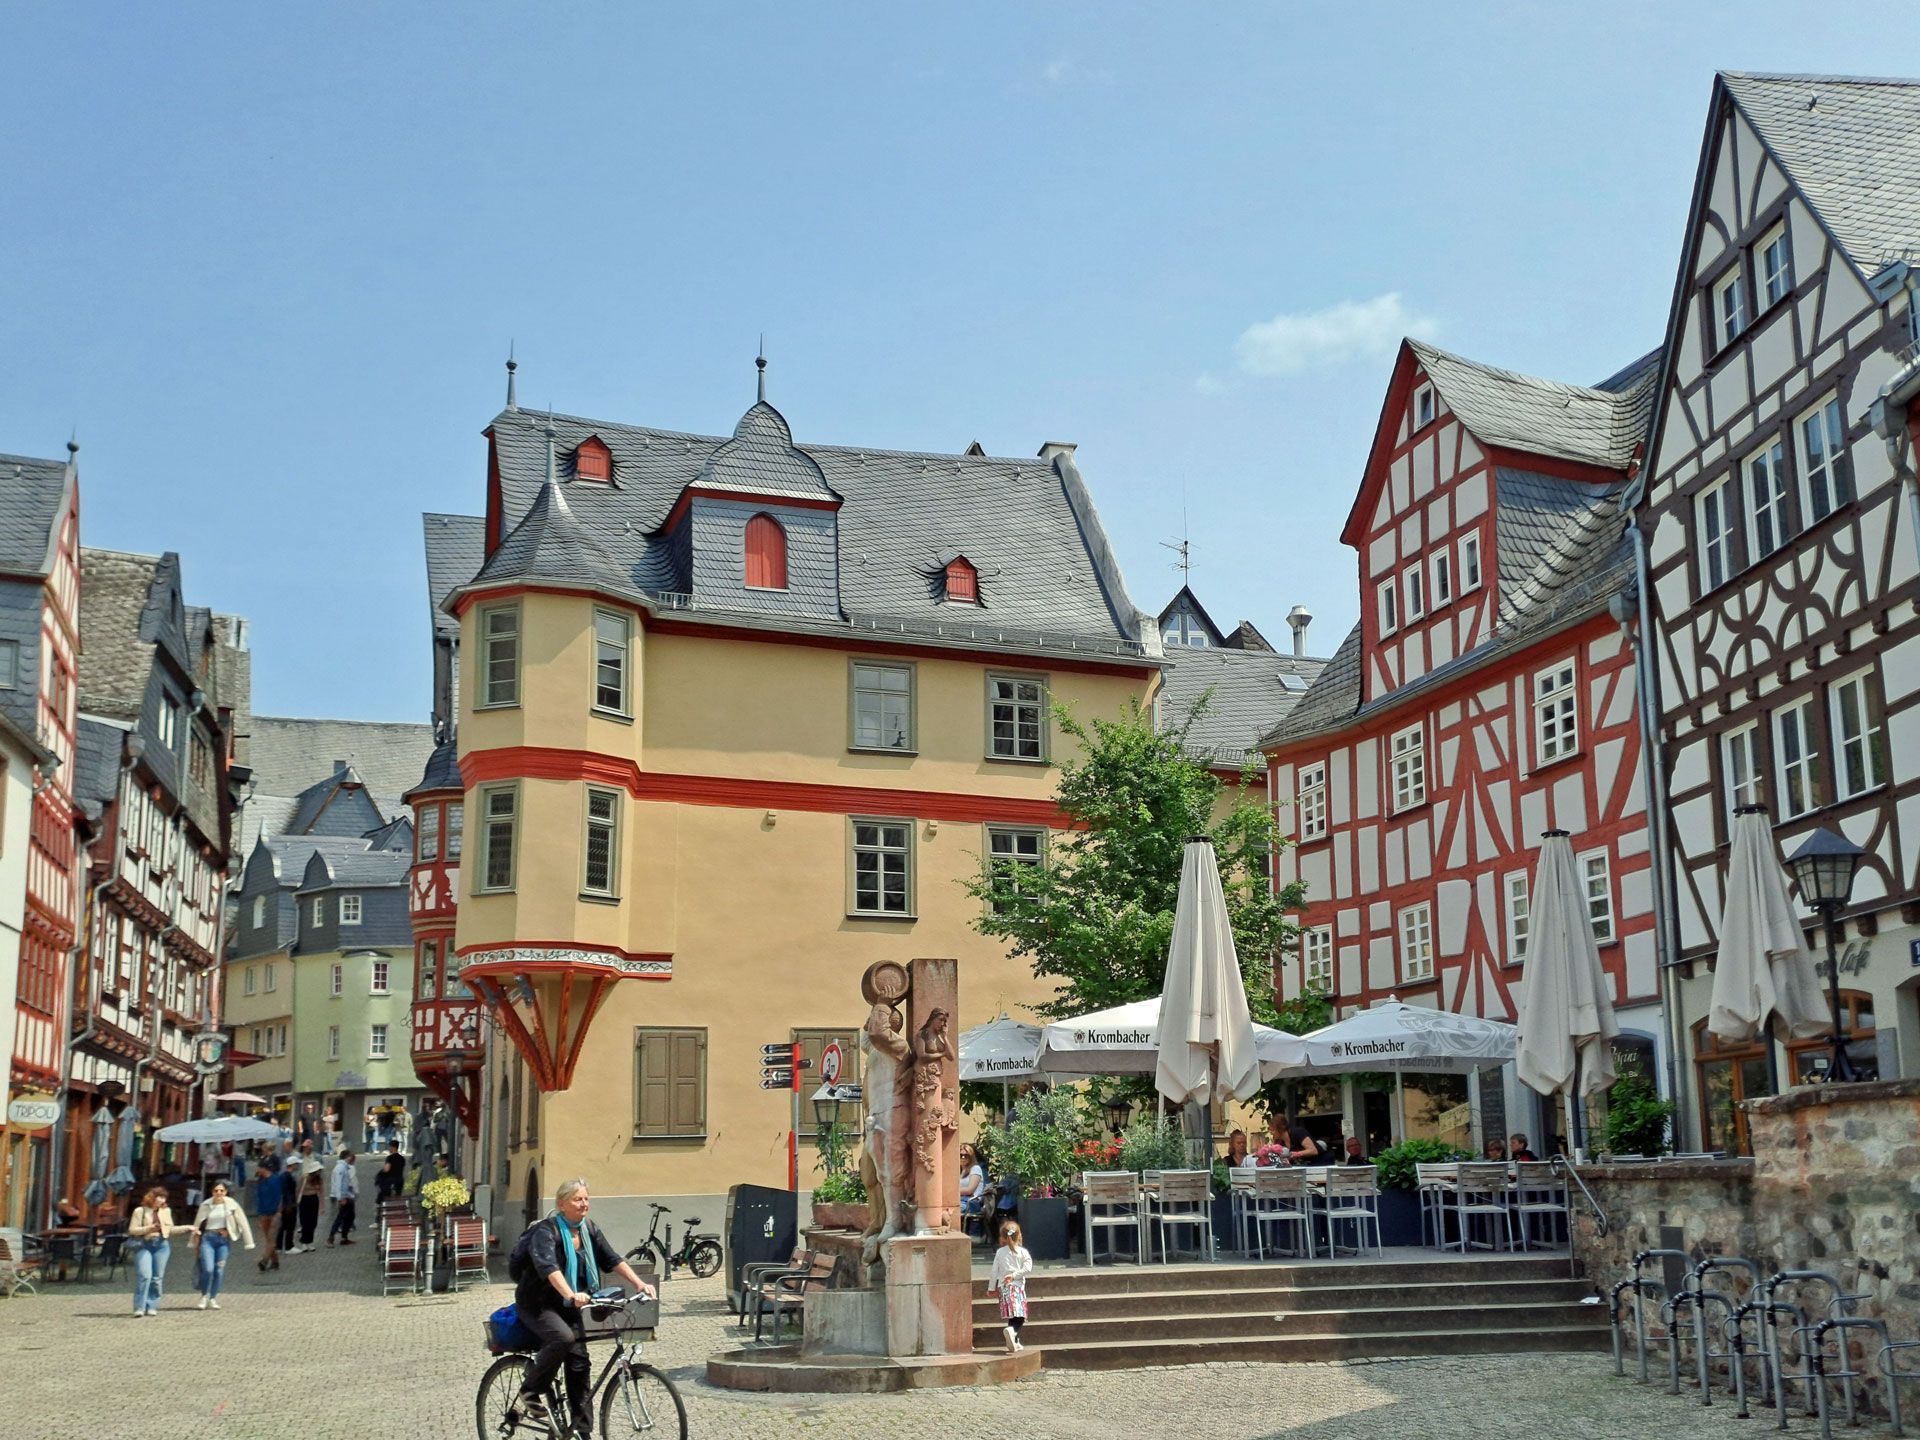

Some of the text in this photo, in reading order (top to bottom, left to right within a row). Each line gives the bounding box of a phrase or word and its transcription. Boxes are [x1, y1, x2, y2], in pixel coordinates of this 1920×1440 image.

[1088, 1029, 1150, 1043] Krombacher
[1345, 1039, 1405, 1056] Krombacher
[986, 1056, 1033, 1071] Krombache
